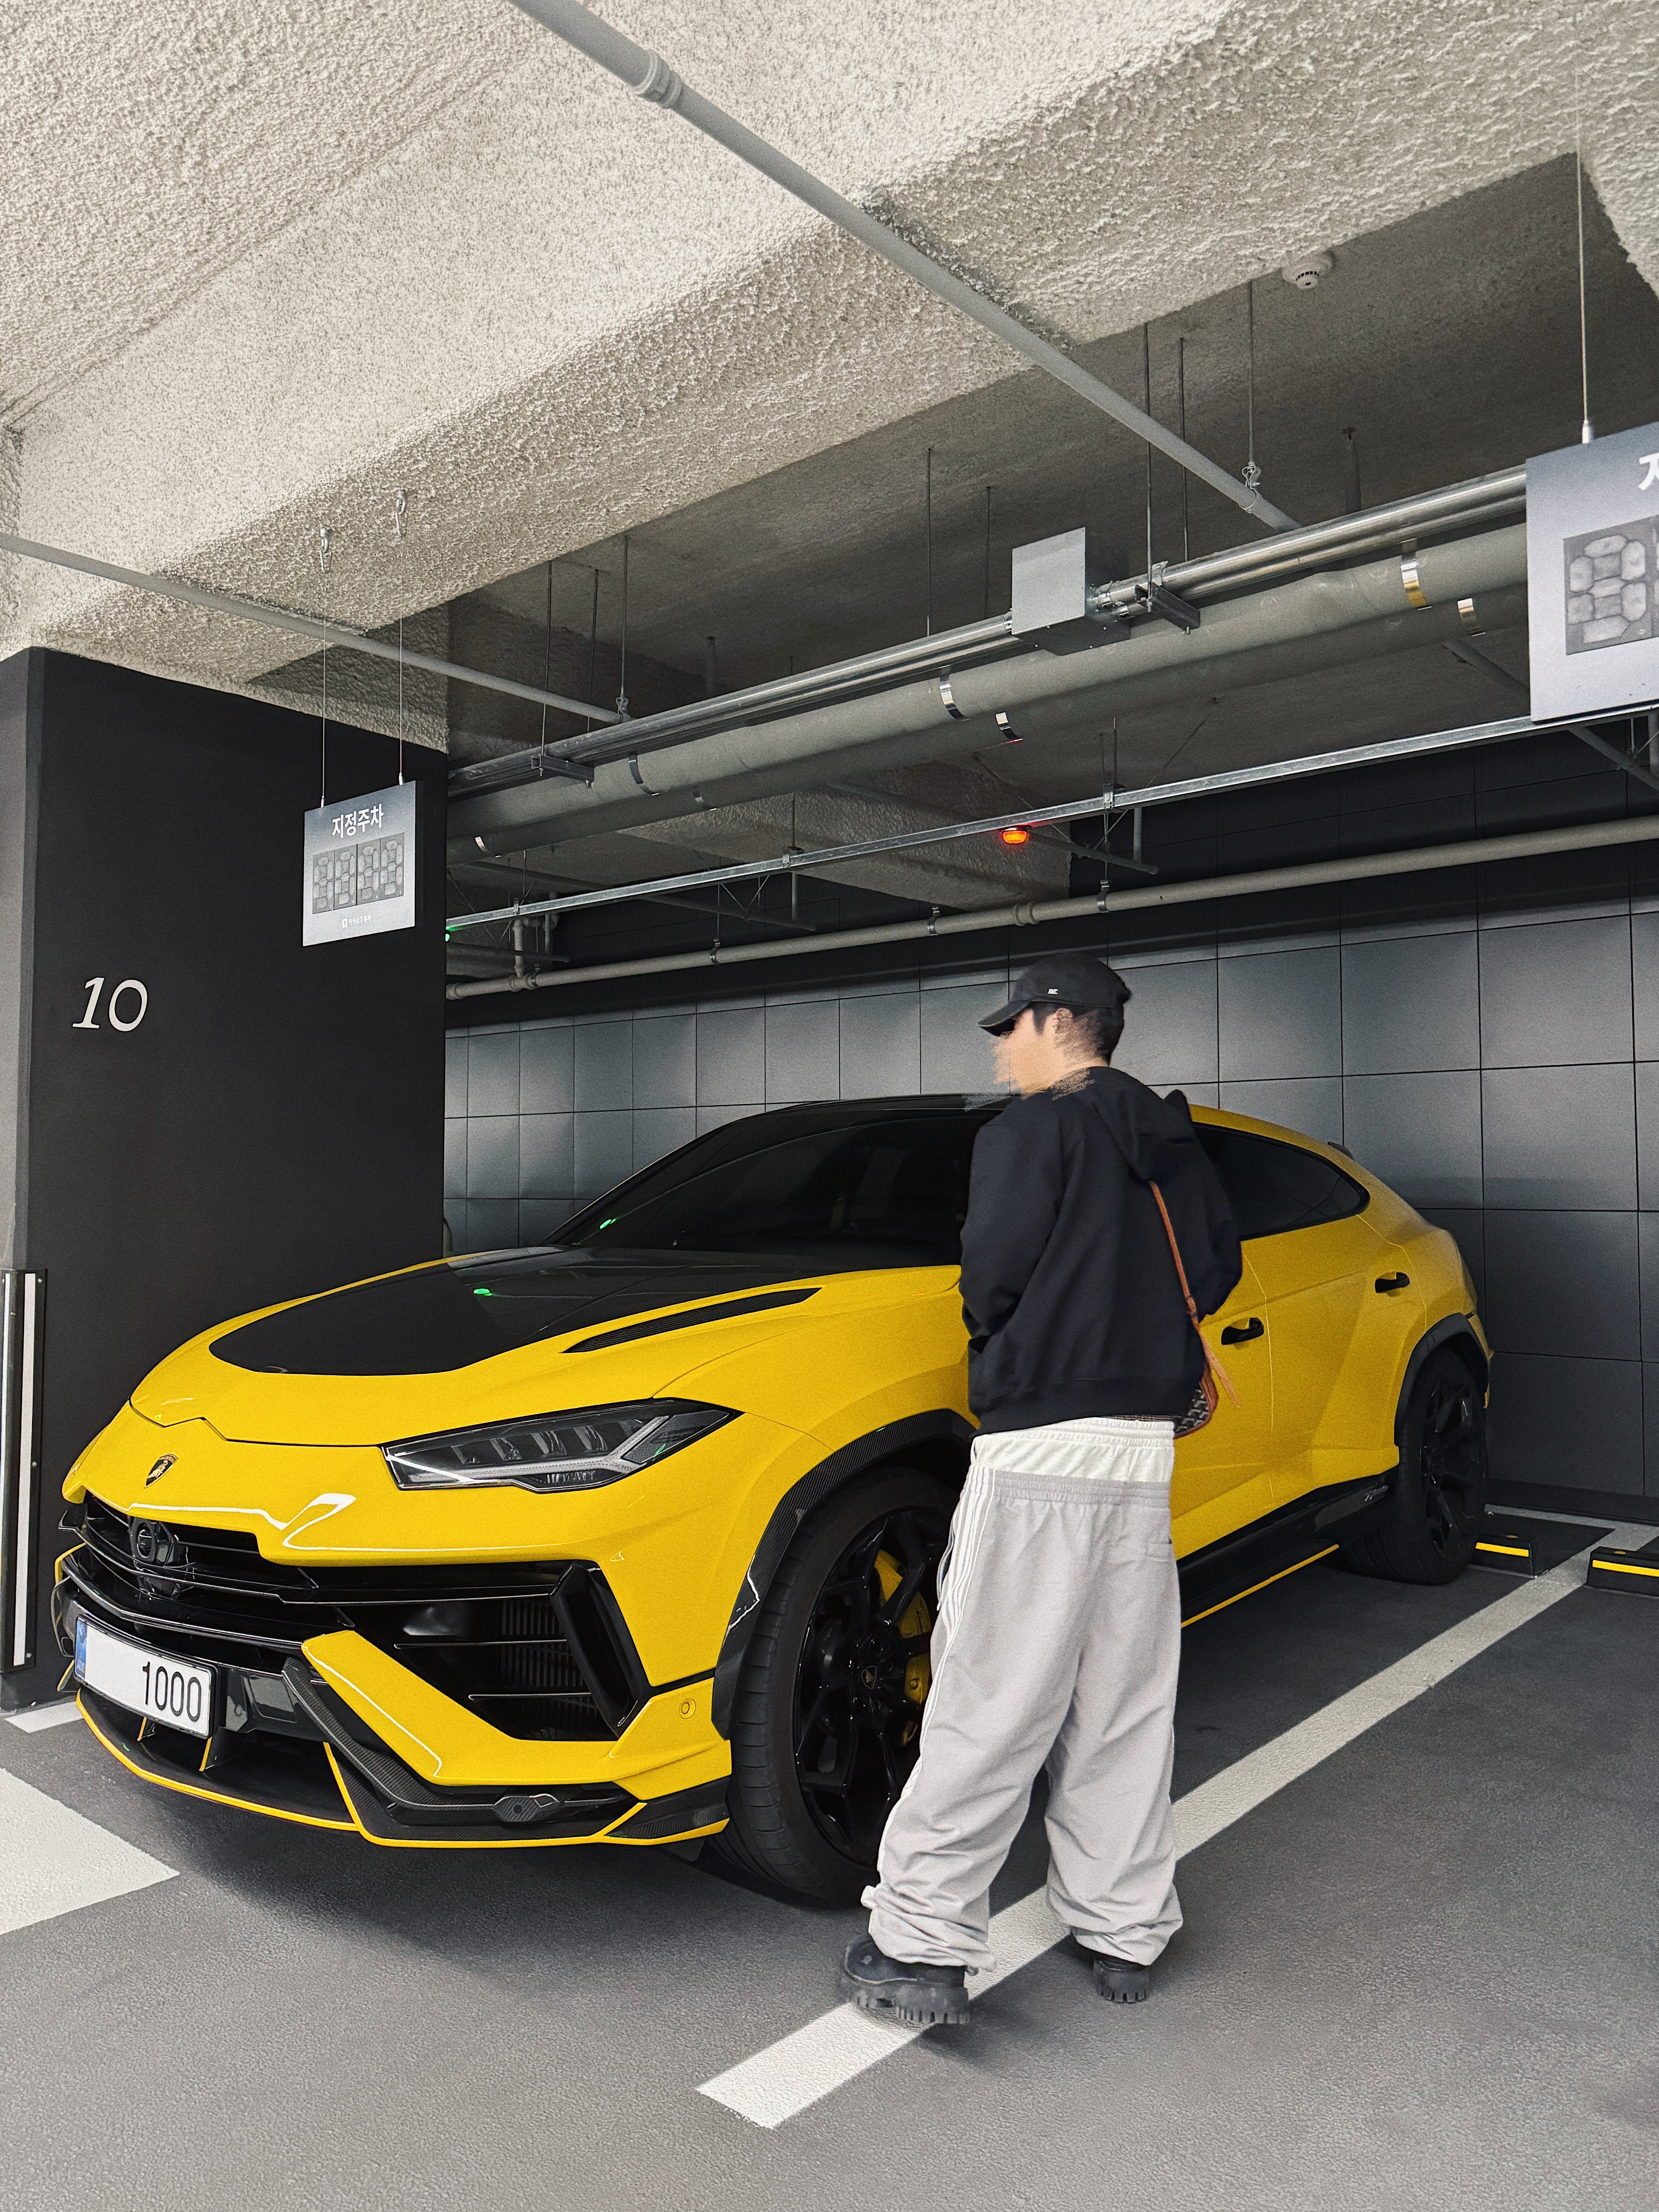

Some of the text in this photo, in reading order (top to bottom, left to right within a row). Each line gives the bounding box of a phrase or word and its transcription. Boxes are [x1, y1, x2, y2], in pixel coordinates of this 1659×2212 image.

[332, 804, 384, 838] 지정주차
[72, 977, 148, 1032] 10
[143, 1661, 201, 1722] 1000
